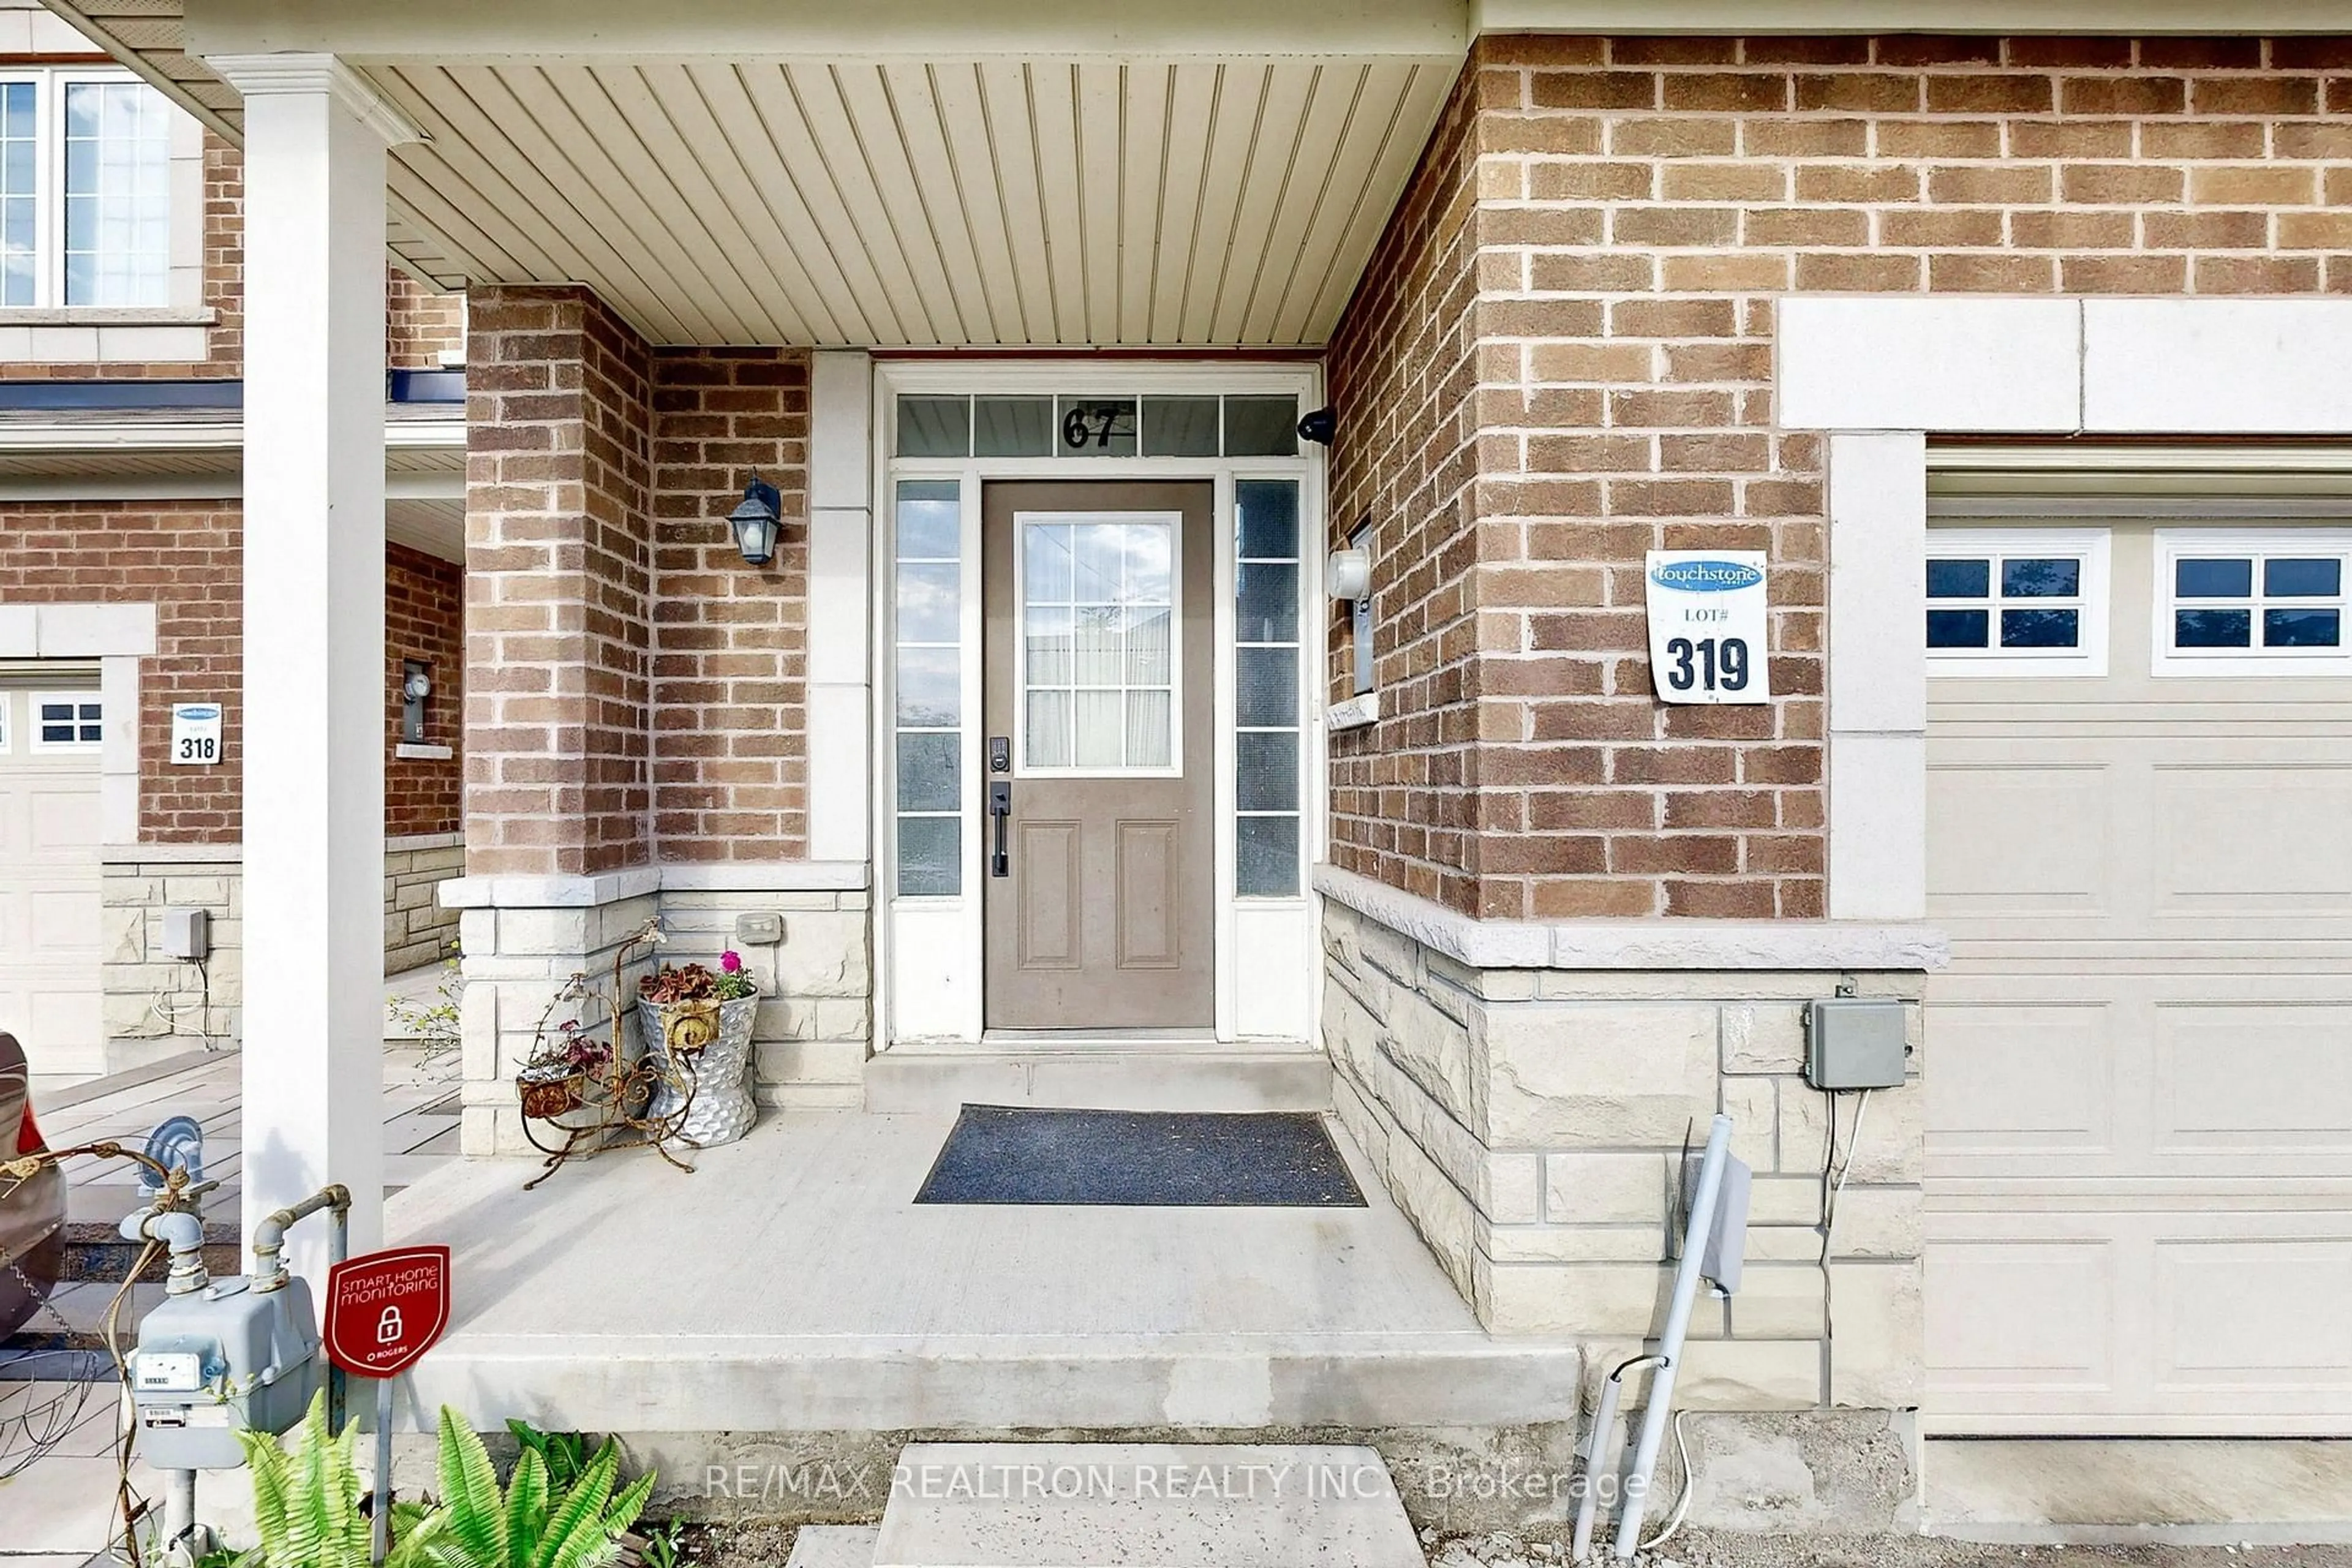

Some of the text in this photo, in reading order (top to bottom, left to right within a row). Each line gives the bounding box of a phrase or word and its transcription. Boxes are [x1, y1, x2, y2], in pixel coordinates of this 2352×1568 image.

[1063, 408, 1120, 448] 67
[1685, 608, 1728, 622] LOT#
[1667, 638, 1749, 691] 319
[180, 737, 214, 759] 318
[376, 1345, 409, 1359] ROGERS
